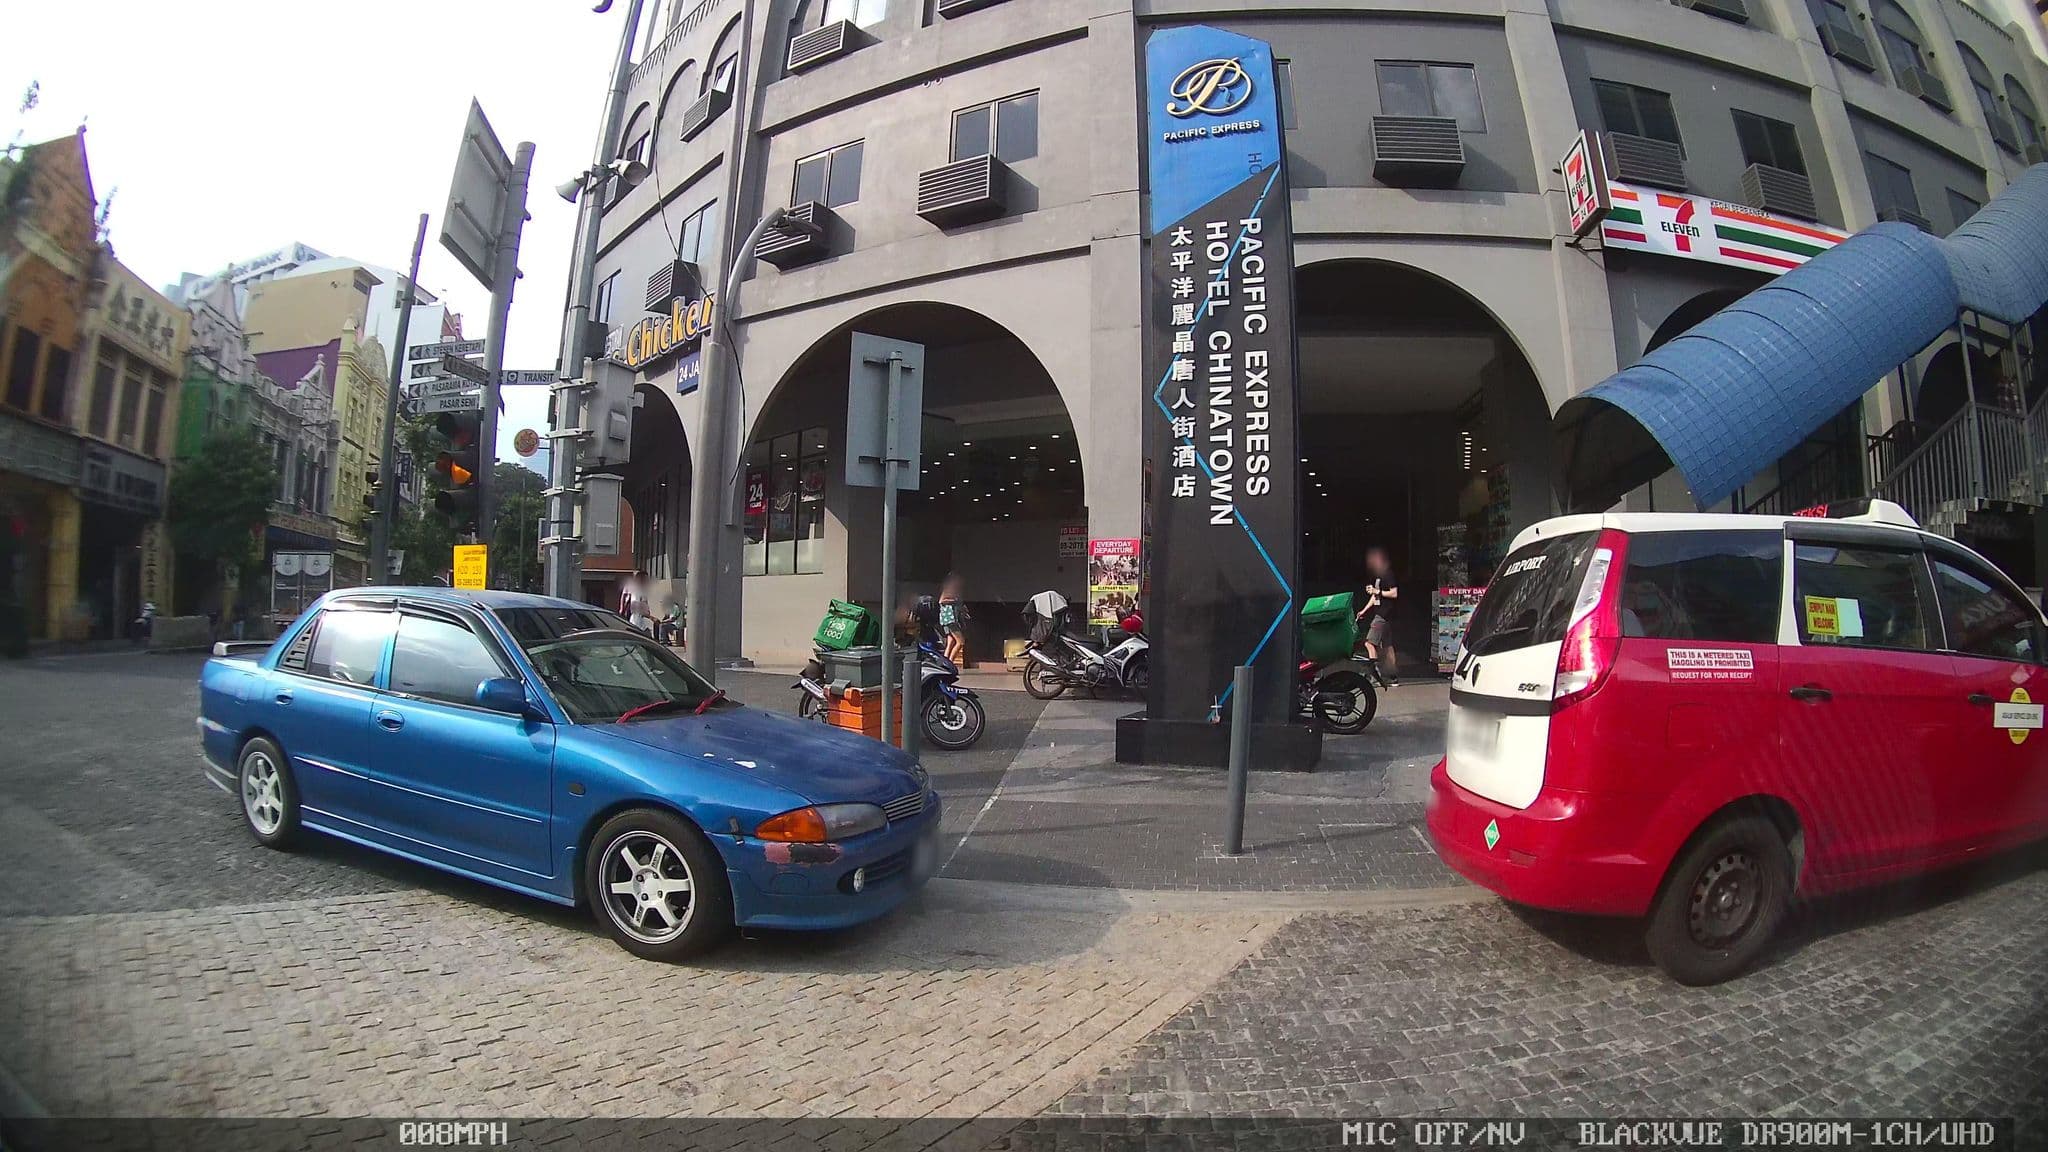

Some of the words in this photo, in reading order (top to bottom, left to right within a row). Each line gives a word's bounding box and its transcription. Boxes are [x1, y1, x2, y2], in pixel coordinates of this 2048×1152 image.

[1163, 127, 1206, 141] PACIFIC
[1211, 120, 1260, 134] EXPRESS
[1205, 221, 1230, 317] HOTEL
[1239, 217, 1267, 334] PACIFIC
[1170, 226, 1196, 498] 太平洋麗晶唐人街酒店
[524, 373, 554, 382] TRANSIT
[679, 366, 688, 382] 24
[440, 398, 460, 409] PASAR
[461, 397, 477, 407] SENI
[1208, 330, 1234, 525] CHINATOWN
[1244, 350, 1270, 496] EXPRESS
[750, 483, 763, 502] 24
[1504, 556, 1547, 577] AIRPORT
[1670, 651, 1686, 659] THIS
[1703, 652, 1734, 660] METERED
[1672, 671, 1699, 679] REQUEST
